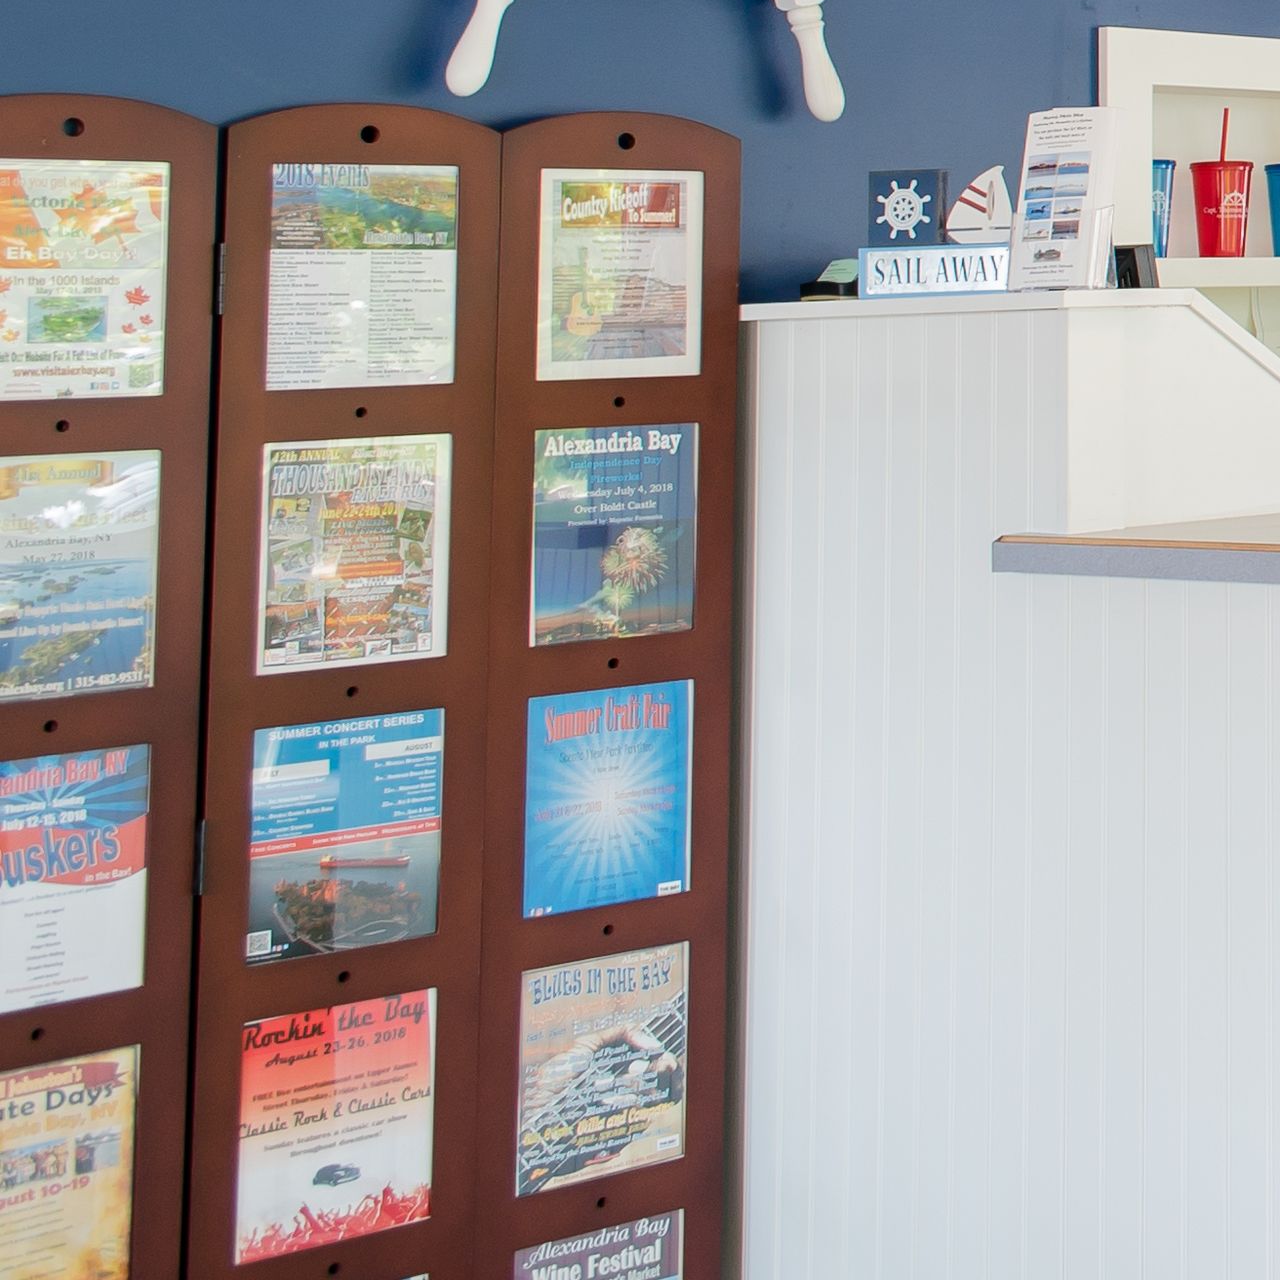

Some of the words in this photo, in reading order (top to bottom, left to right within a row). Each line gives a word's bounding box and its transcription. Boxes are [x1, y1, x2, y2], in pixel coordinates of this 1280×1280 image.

[275, 164, 315, 187] 2018
[320, 164, 370, 188] Events
[563, 195, 607, 221] Country
[610, 184, 649, 212] Kickoff
[628, 209, 639, 223] To
[6, 246, 32, 260] Eh
[38, 247, 76, 262] Bay
[28, 276, 45, 286] the
[51, 275, 78, 286] 1000
[81, 275, 120, 285] Islands
[874, 256, 927, 286] SAIL
[936, 255, 1004, 283] AWAY
[544, 431, 643, 456] Alexandria
[647, 430, 682, 455] Bay
[570, 456, 641, 470] Independence
[644, 455, 662, 466] Day
[272, 463, 363, 496] THOUSAND
[365, 459, 434, 487] ISLANDS
[614, 485, 636, 497] July
[650, 483, 674, 494] 2018
[350, 486, 397, 504] RIVER
[401, 485, 434, 502] RUN
[574, 504, 597, 514] Over
[600, 502, 625, 513] Boldt
[627, 500, 657, 511] Castle
[5, 536, 66, 549] Alexandria
[94, 533, 112, 543] NY
[22, 555, 46, 565] May
[71, 550, 96, 561] 2018
[268, 726, 321, 741] SUMMER
[324, 719, 381, 735] CONCERT
[383, 714, 425, 728] SERIES
[544, 706, 602, 745] Summer
[605, 694, 641, 732] Craft
[643, 692, 672, 729] Fair
[318, 741, 329, 750] IN
[331, 738, 349, 748] THE
[350, 735, 376, 746] PARK
[405, 742, 433, 752] AUGUST
[65, 758, 101, 784] Bay
[104, 748, 129, 776] NY
[2, 818, 25, 831] July
[60, 809, 88, 824] 2018
[0, 824, 121, 888] uskers
[587, 968, 601, 995] IN
[607, 967, 637, 996] THE
[337, 1007, 375, 1033] the
[384, 995, 426, 1025] Bay
[265, 1050, 318, 1067] August
[374, 1027, 407, 1045] 2018
[46, 1082, 113, 1112] Days
[252, 1092, 273, 1102] FREE
[239, 1118, 289, 1140] Classic
[294, 1108, 328, 1127] Rock
[348, 1092, 397, 1114] Classic
[401, 1086, 431, 1102] Cars
[40, 1175, 91, 1198] 10-19
[522, 1225, 630, 1270] Alexandria
[634, 1217, 671, 1238] Bay
[531, 1262, 582, 1280] Wine
[587, 1238, 663, 1279] Festival
